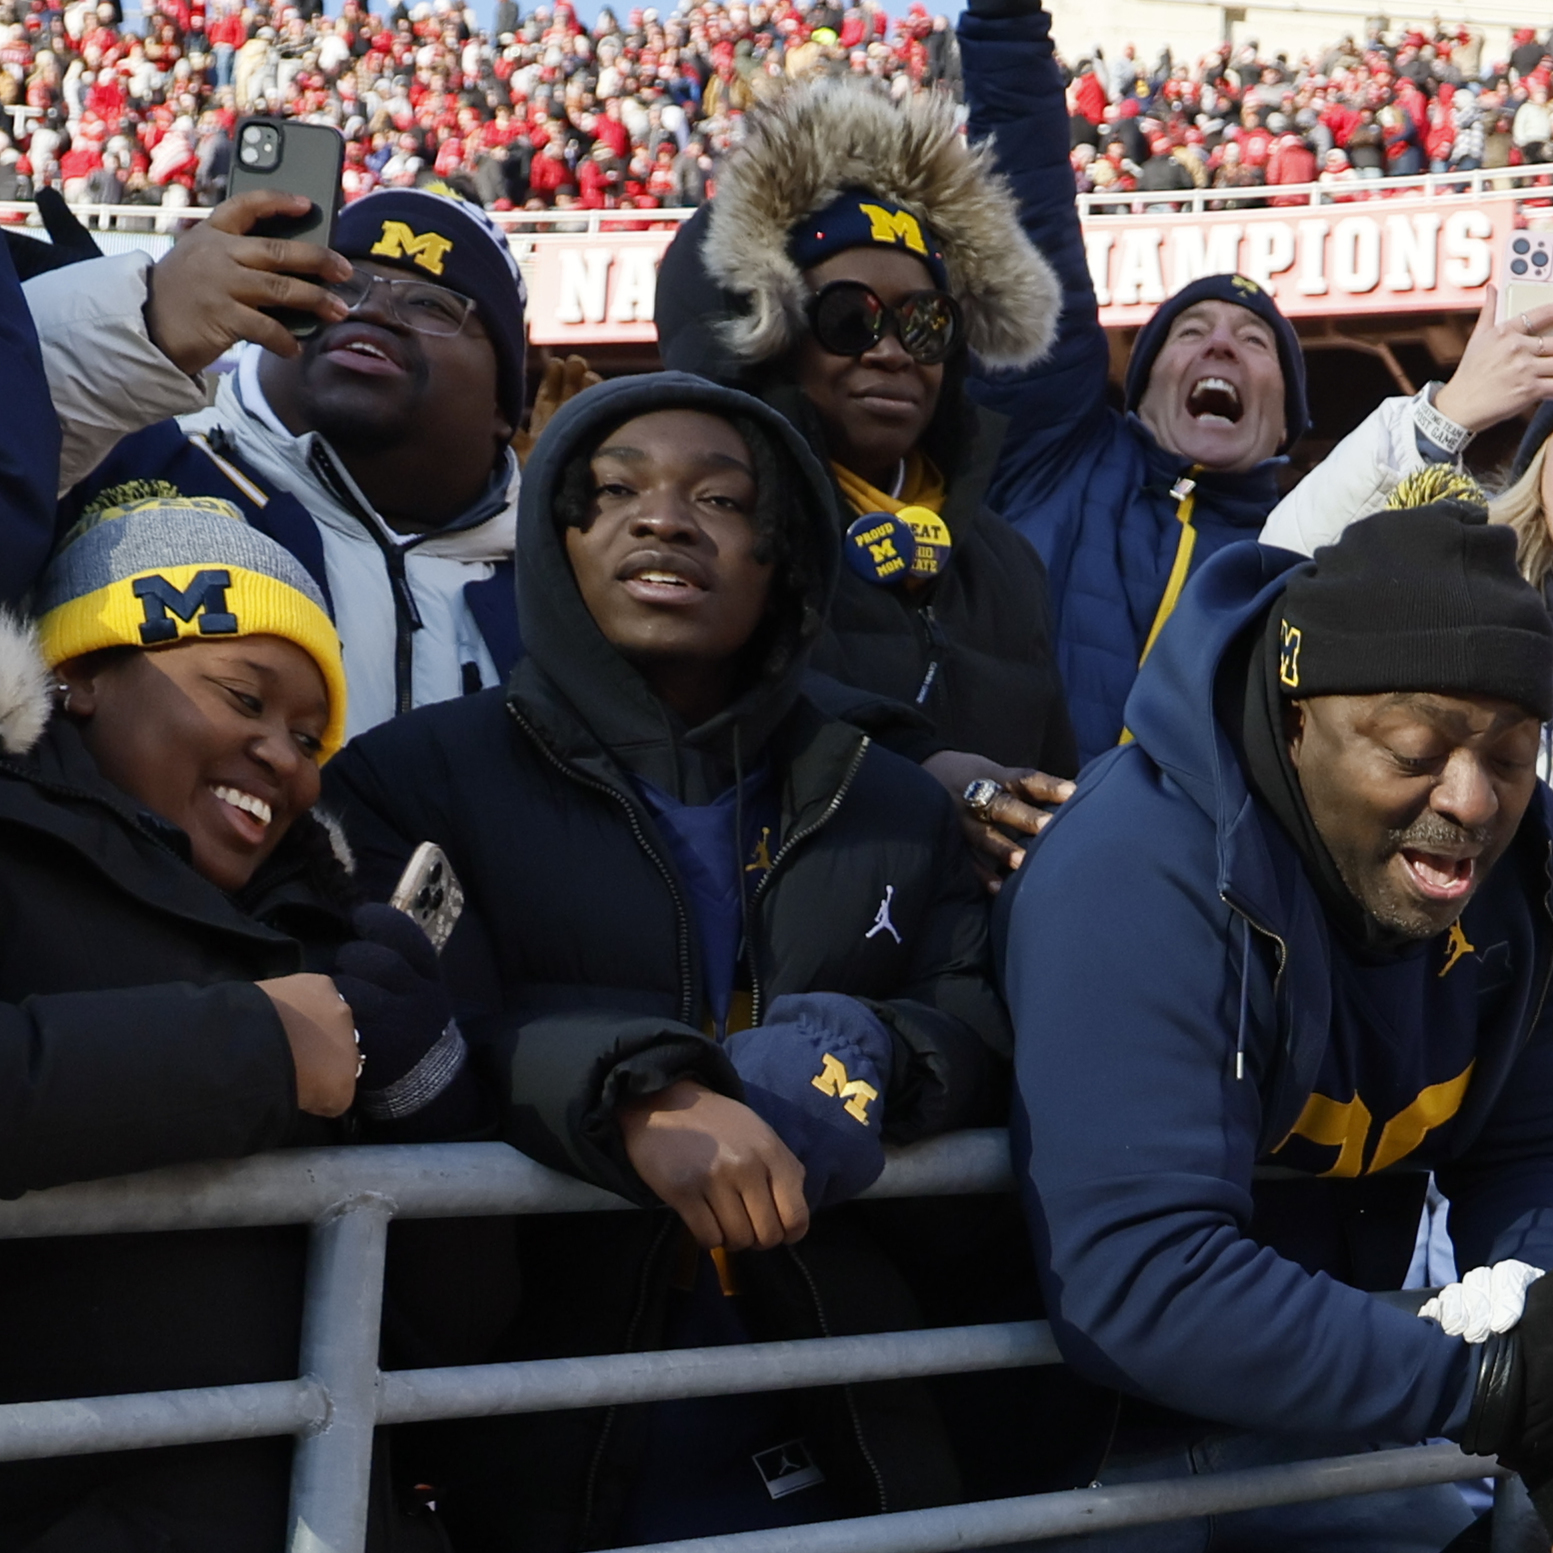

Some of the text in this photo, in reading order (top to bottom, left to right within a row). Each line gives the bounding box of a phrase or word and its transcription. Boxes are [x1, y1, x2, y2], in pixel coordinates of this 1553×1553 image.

[369, 219, 454, 276] M
[858, 203, 929, 256] M
[555, 245, 657, 324] NA
[854, 521, 896, 549] PROUD
[868, 537, 898, 564] M
[875, 556, 906, 578] MOM
[132, 569, 239, 646] M
[810, 1051, 879, 1123] M
